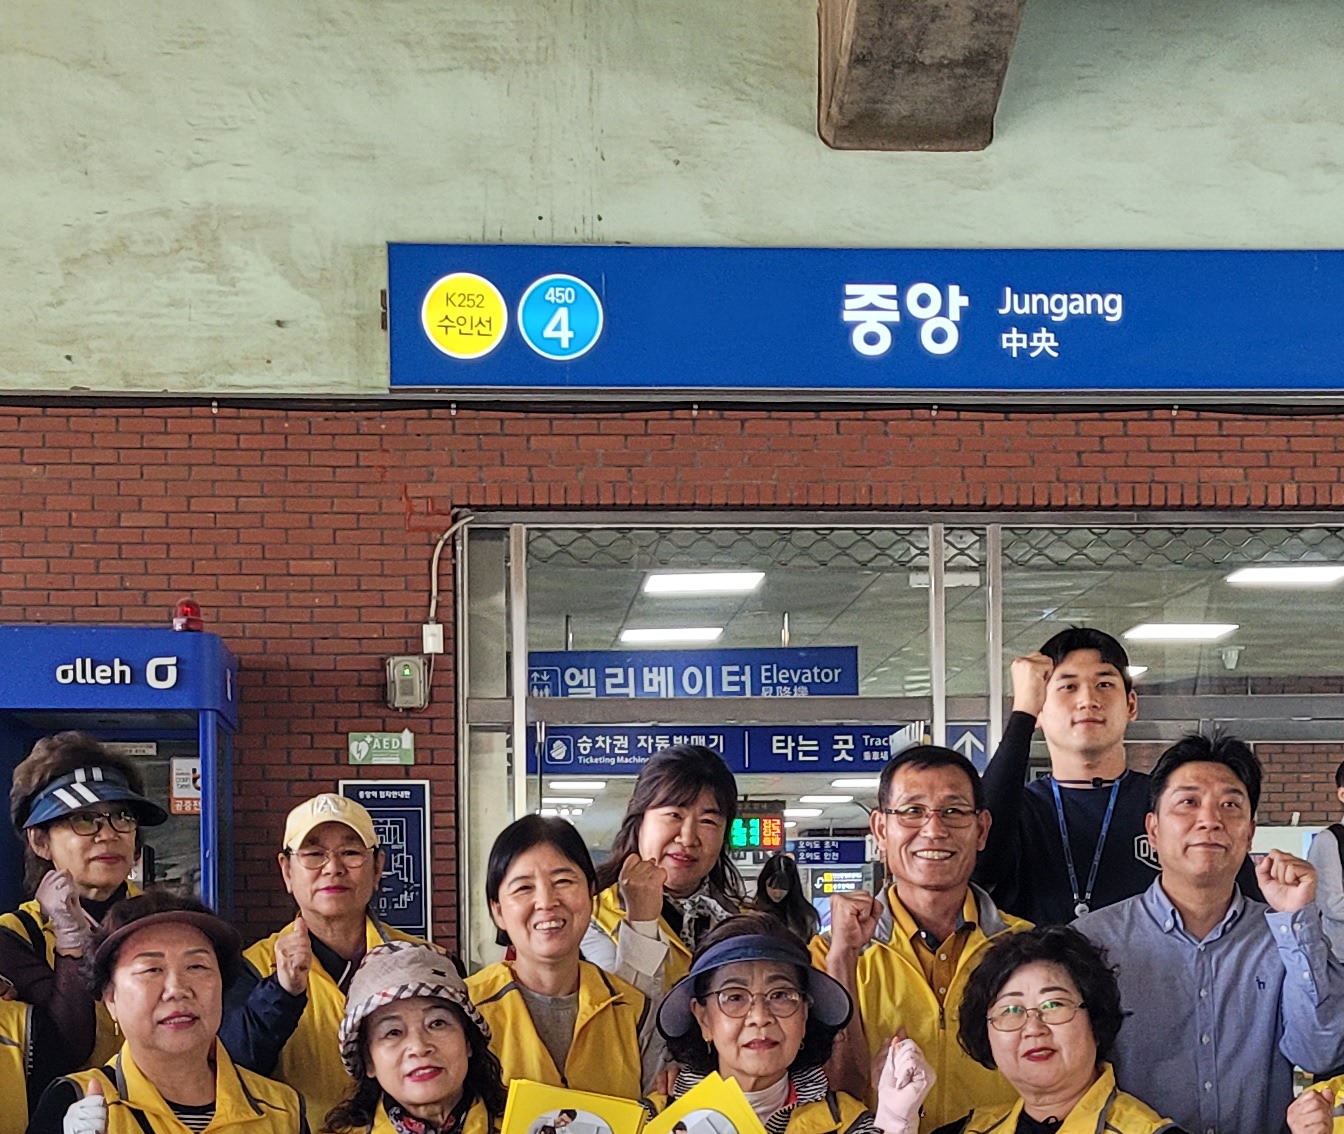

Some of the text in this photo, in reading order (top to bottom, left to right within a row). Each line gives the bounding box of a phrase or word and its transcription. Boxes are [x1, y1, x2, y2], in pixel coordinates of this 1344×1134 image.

[445, 292, 485, 309] K252
[544, 287, 576, 305] 450
[998, 286, 1124, 322] Jungang
[436, 314, 493, 337] 수인선
[542, 306, 575, 349] 4
[842, 282, 970, 356] 중앙
[1001, 326, 1060, 358] 中央
[55, 657, 132, 685] olleh
[564, 664, 752, 698] 엘리베이터
[760, 663, 842, 684] Elevator
[372, 737, 401, 750] AED
[577, 735, 629, 755] 승차권
[771, 734, 855, 762] 타는 곳
[862, 735, 891, 746] Trac
[577, 755, 616, 766] Ticketing
[797, 852, 821, 861] 오이도
